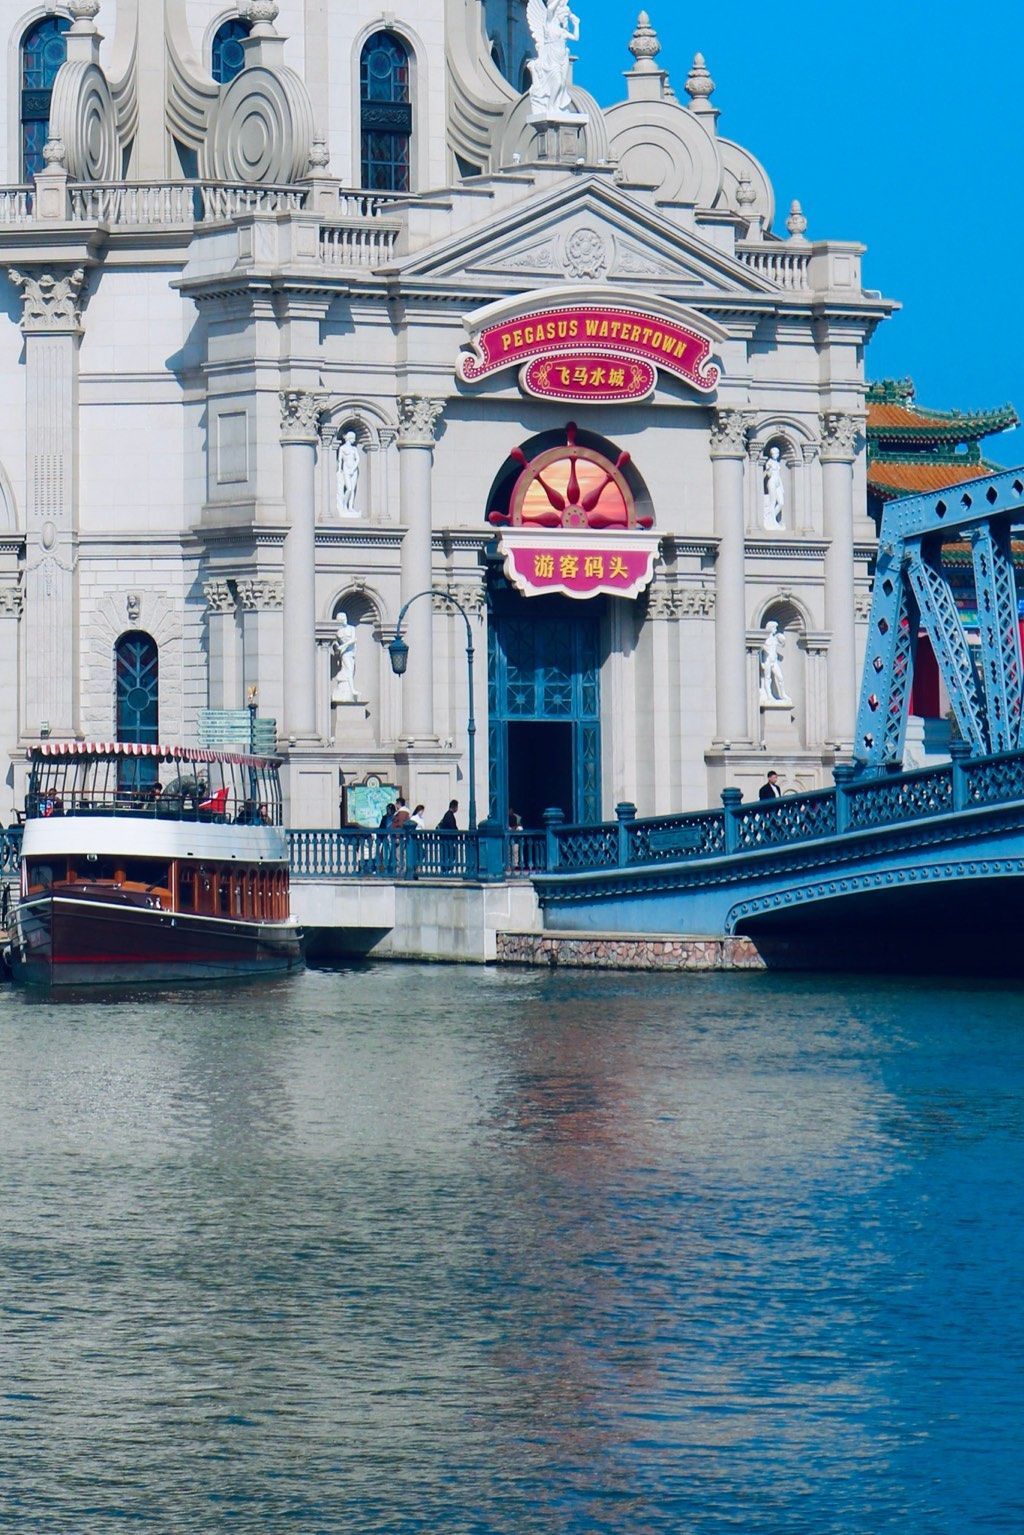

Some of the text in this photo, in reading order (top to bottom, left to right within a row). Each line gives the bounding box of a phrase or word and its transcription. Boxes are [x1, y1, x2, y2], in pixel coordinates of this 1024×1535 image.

[501, 320, 688, 359] PEGASUS WATERTOWN
[555, 367, 625, 388] 飞马水城
[534, 554, 629, 579] 游客码头
